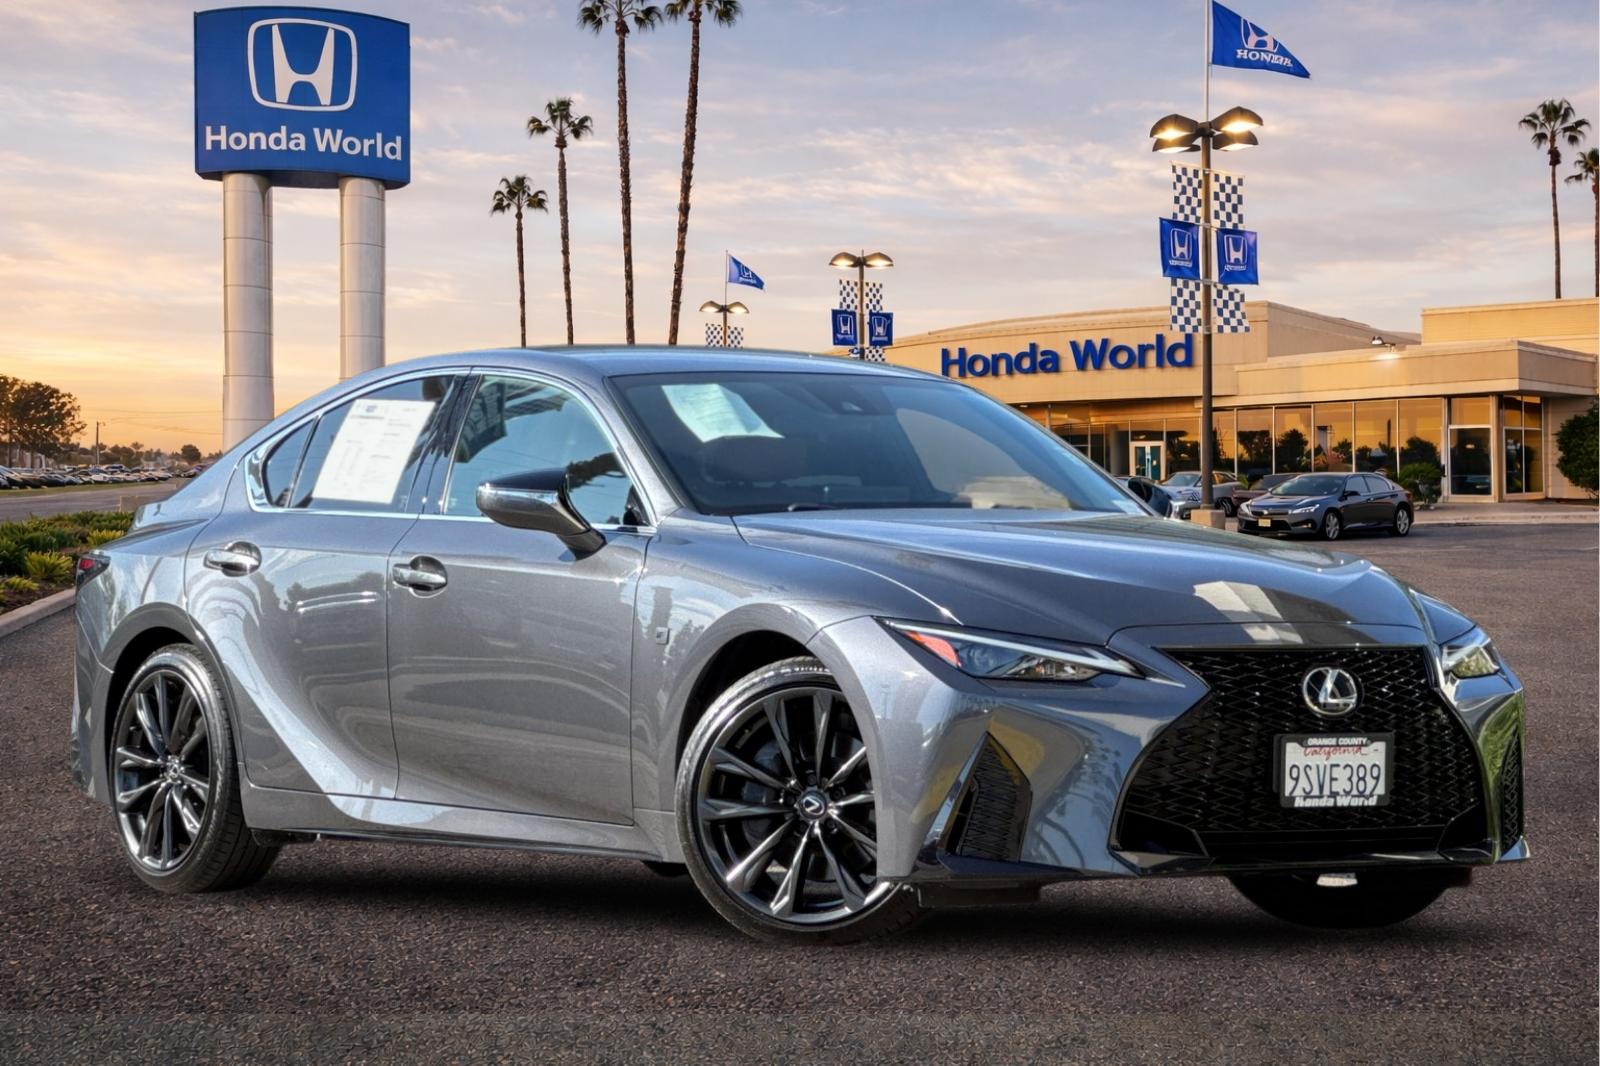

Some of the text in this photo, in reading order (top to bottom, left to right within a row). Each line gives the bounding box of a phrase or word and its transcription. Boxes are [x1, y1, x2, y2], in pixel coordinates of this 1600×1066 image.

[205, 125, 402, 160] Honda World
[941, 333, 1193, 378] Honda World
[1307, 737, 1367, 745] ORANGE COUNTY
[1304, 746, 1367, 760] California
[1289, 763, 1381, 796] 9SVE389
[1294, 796, 1335, 807] Honda
